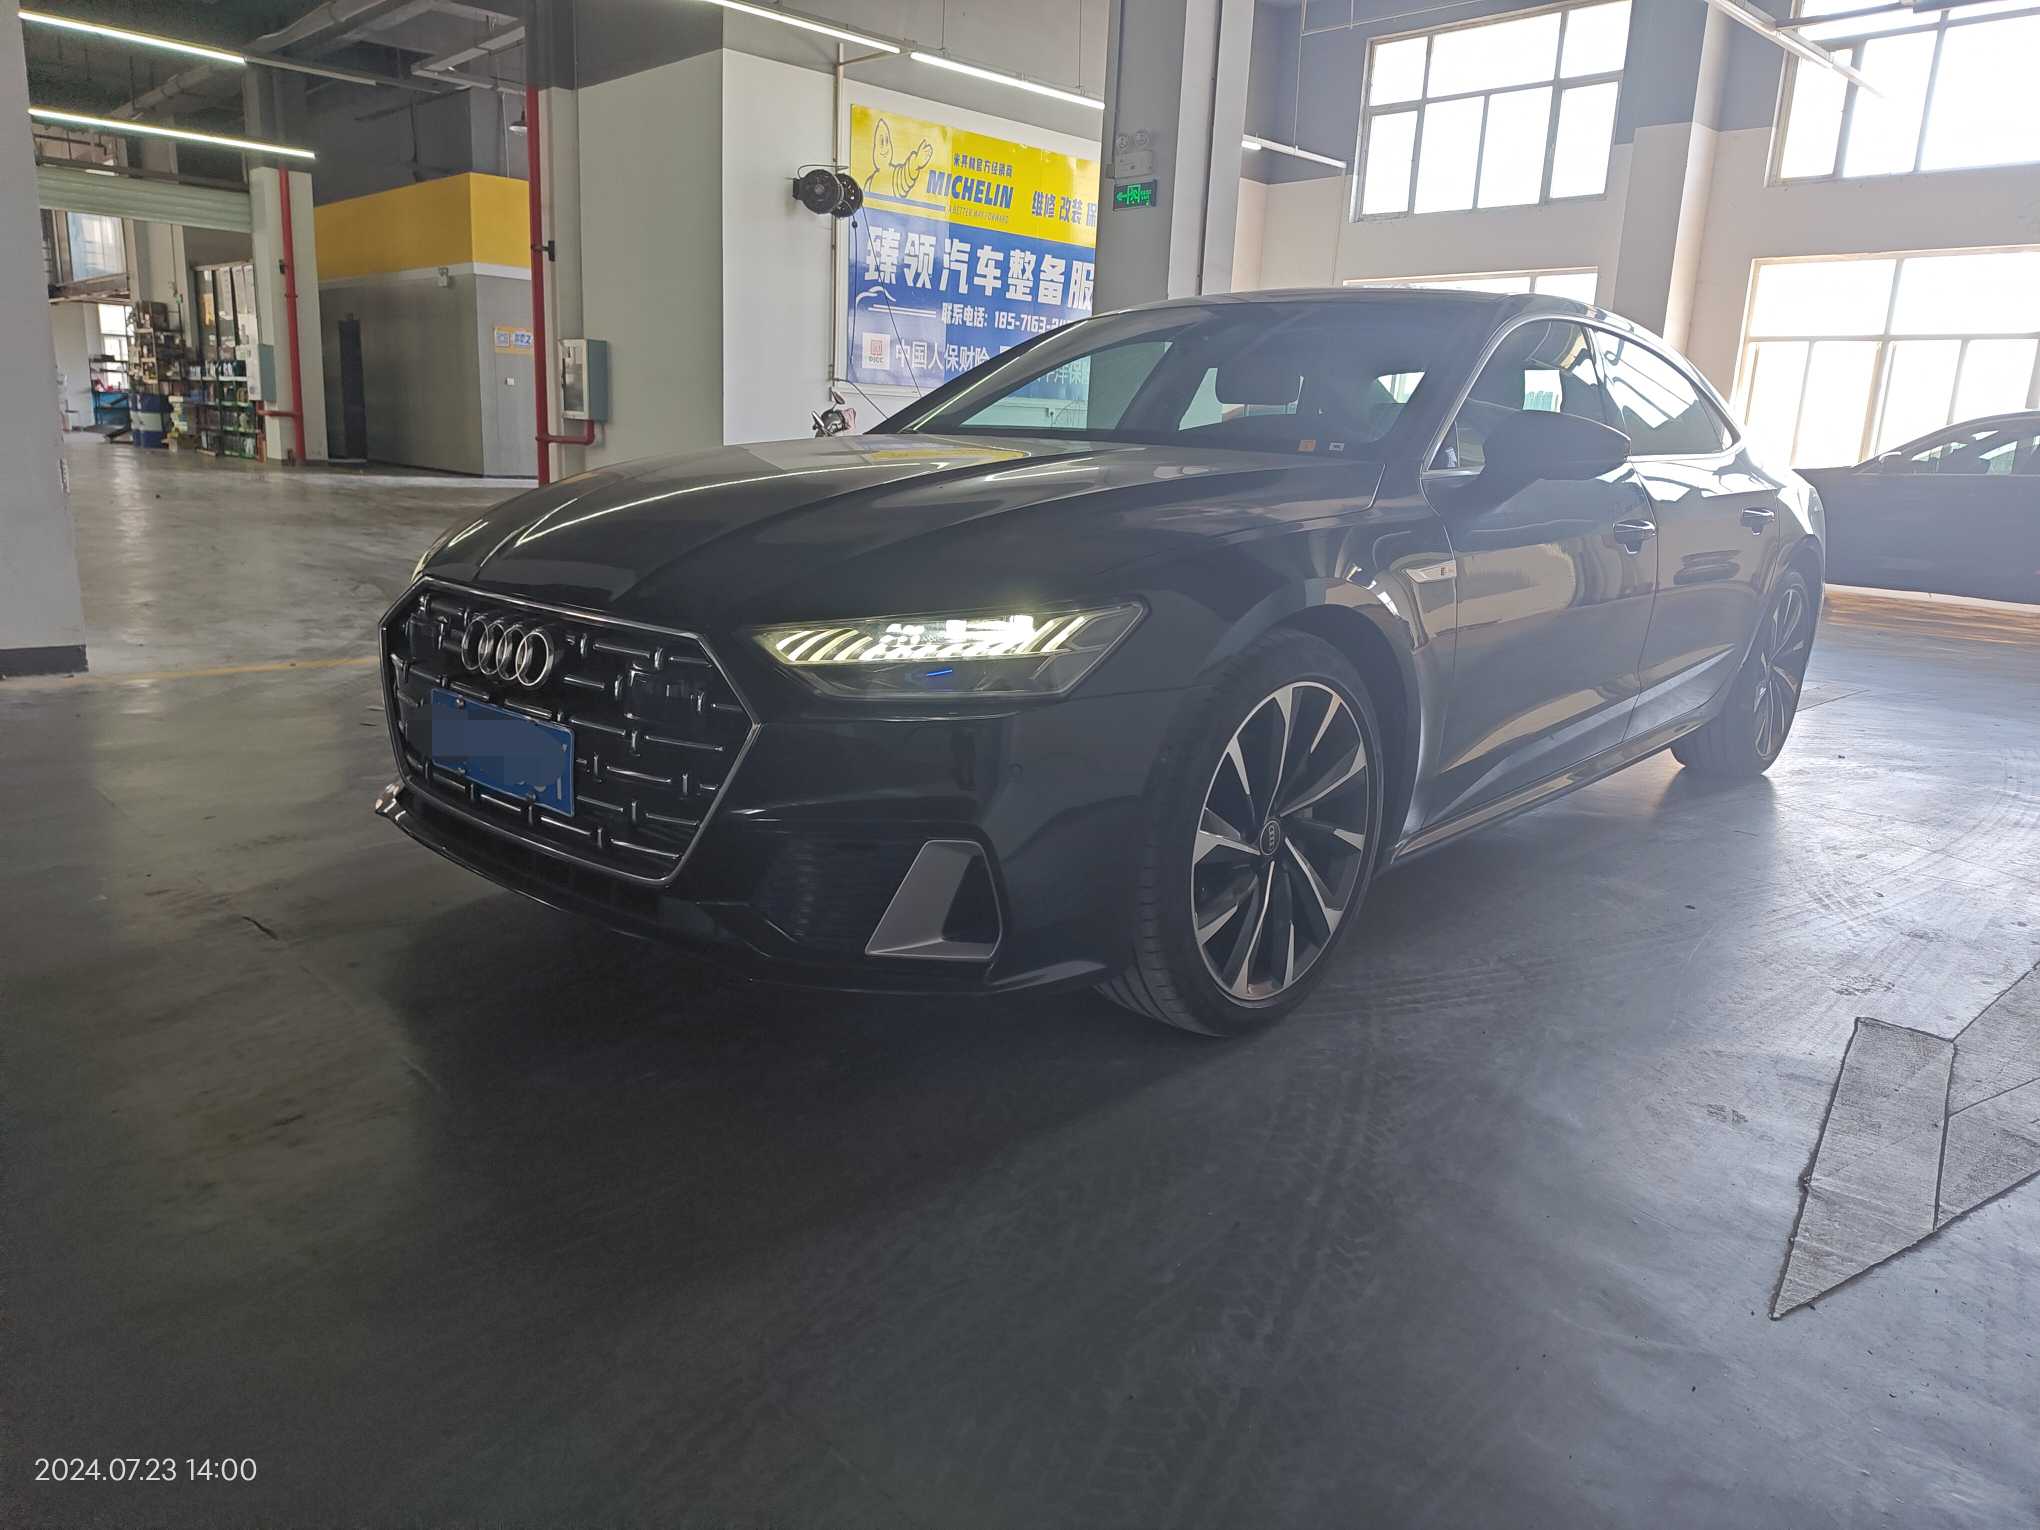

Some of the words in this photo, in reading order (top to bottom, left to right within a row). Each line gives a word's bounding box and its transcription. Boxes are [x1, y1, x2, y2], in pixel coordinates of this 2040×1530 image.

[926, 169, 1014, 209] MICHELIN
[1032, 190, 1056, 218] 维修
[1059, 196, 1083, 225] 改装
[864, 226, 1095, 311] 臻领汽车整备服
